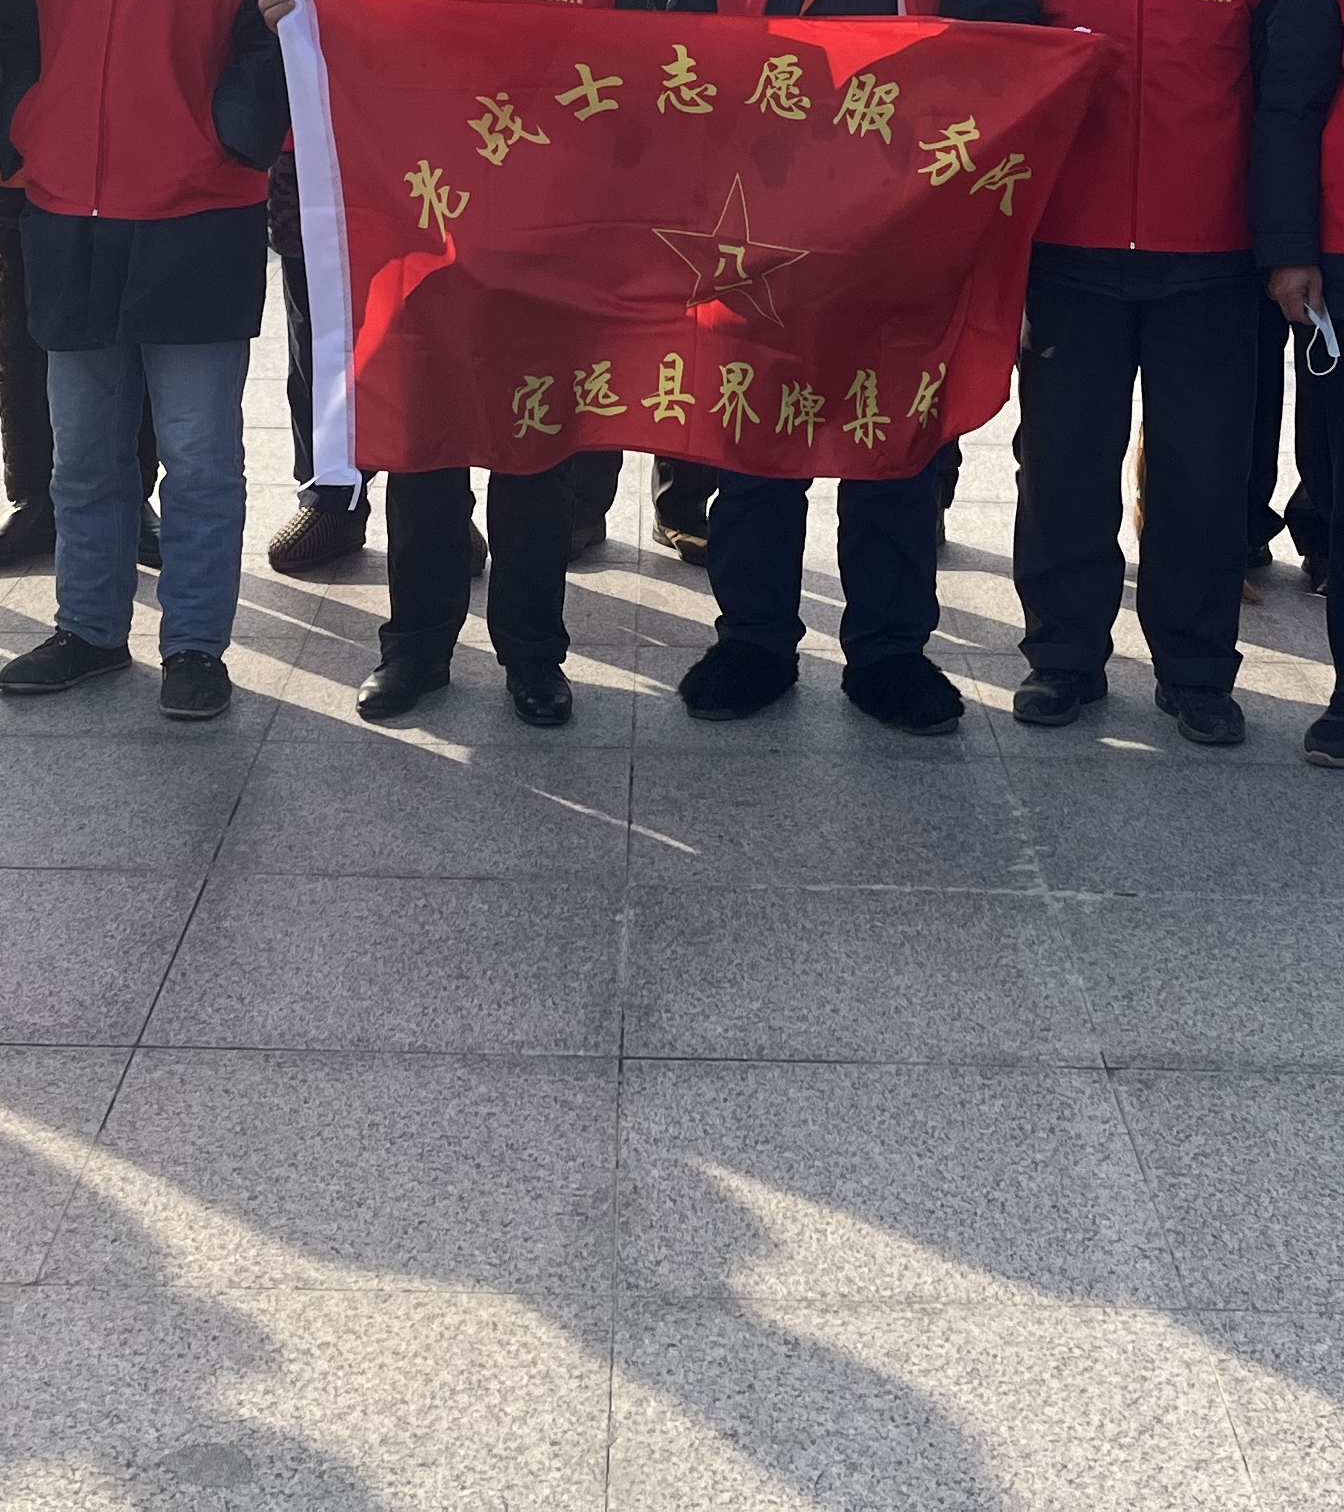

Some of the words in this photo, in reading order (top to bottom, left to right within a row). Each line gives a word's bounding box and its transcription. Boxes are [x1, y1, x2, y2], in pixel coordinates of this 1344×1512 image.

[402, 44, 1032, 240] 老战士志愿服务队
